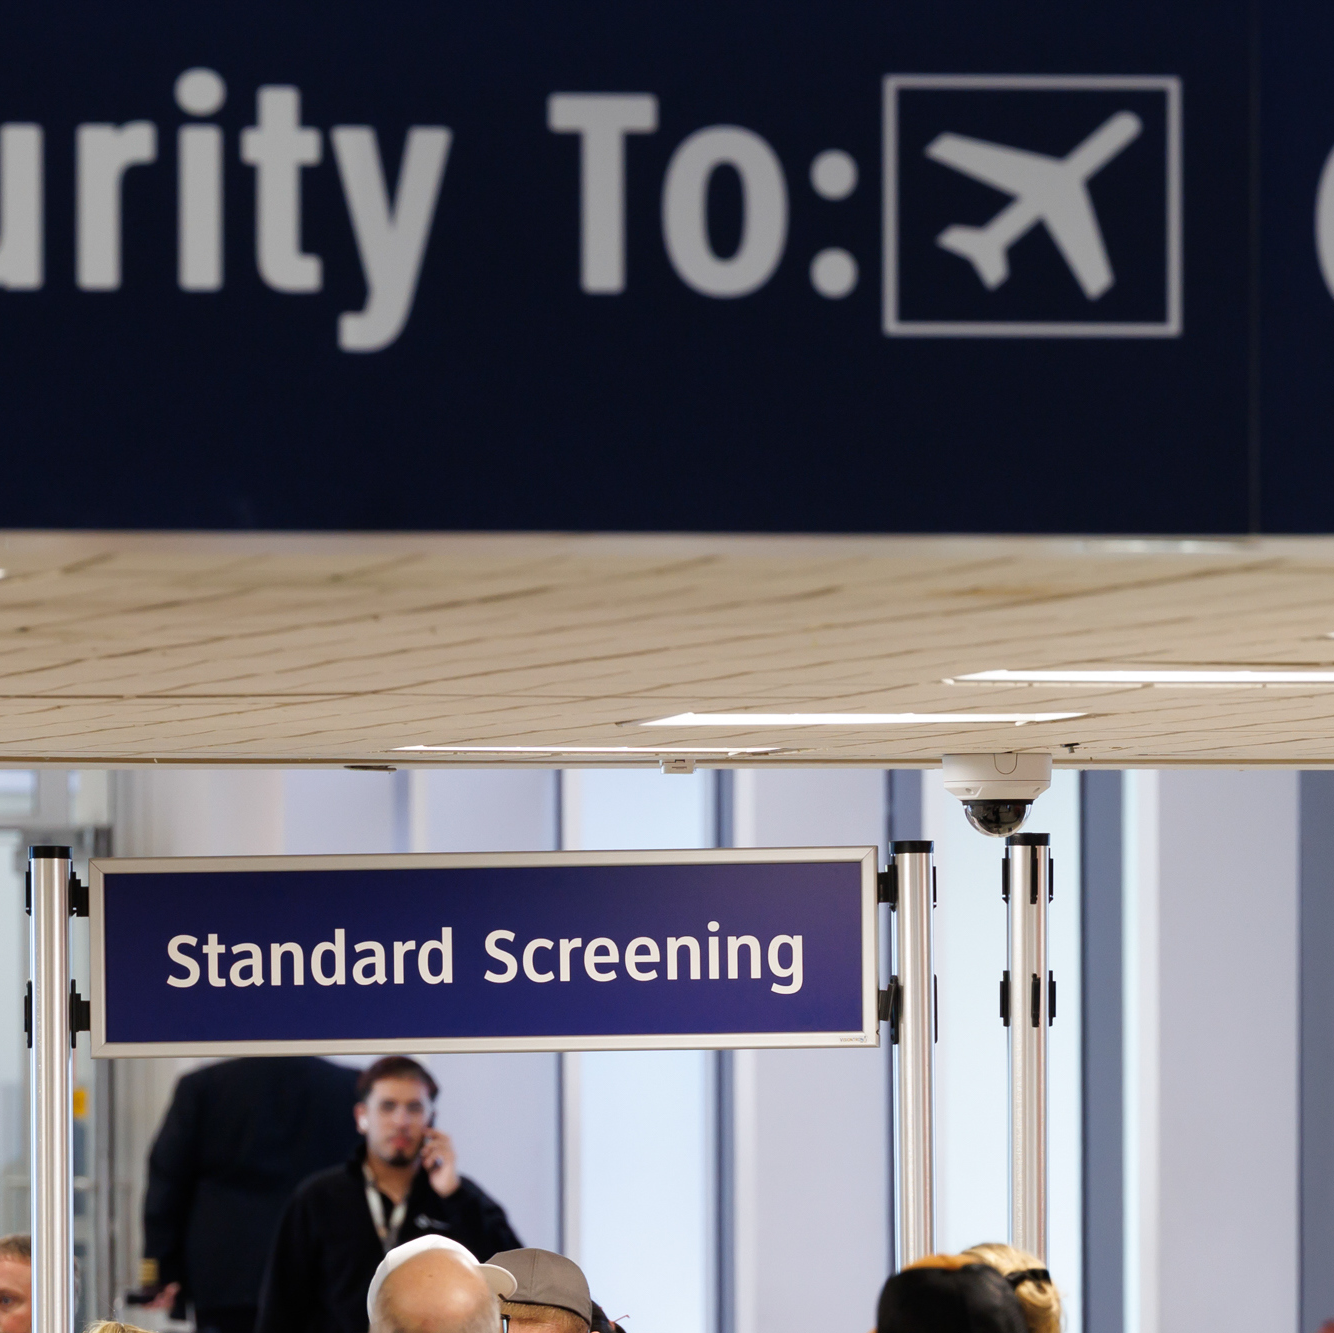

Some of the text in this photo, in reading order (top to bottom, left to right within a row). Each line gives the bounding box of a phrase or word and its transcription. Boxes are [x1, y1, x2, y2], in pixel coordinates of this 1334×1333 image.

[548, 93, 857, 298] To:
[166, 920, 804, 995] Standard Screening
